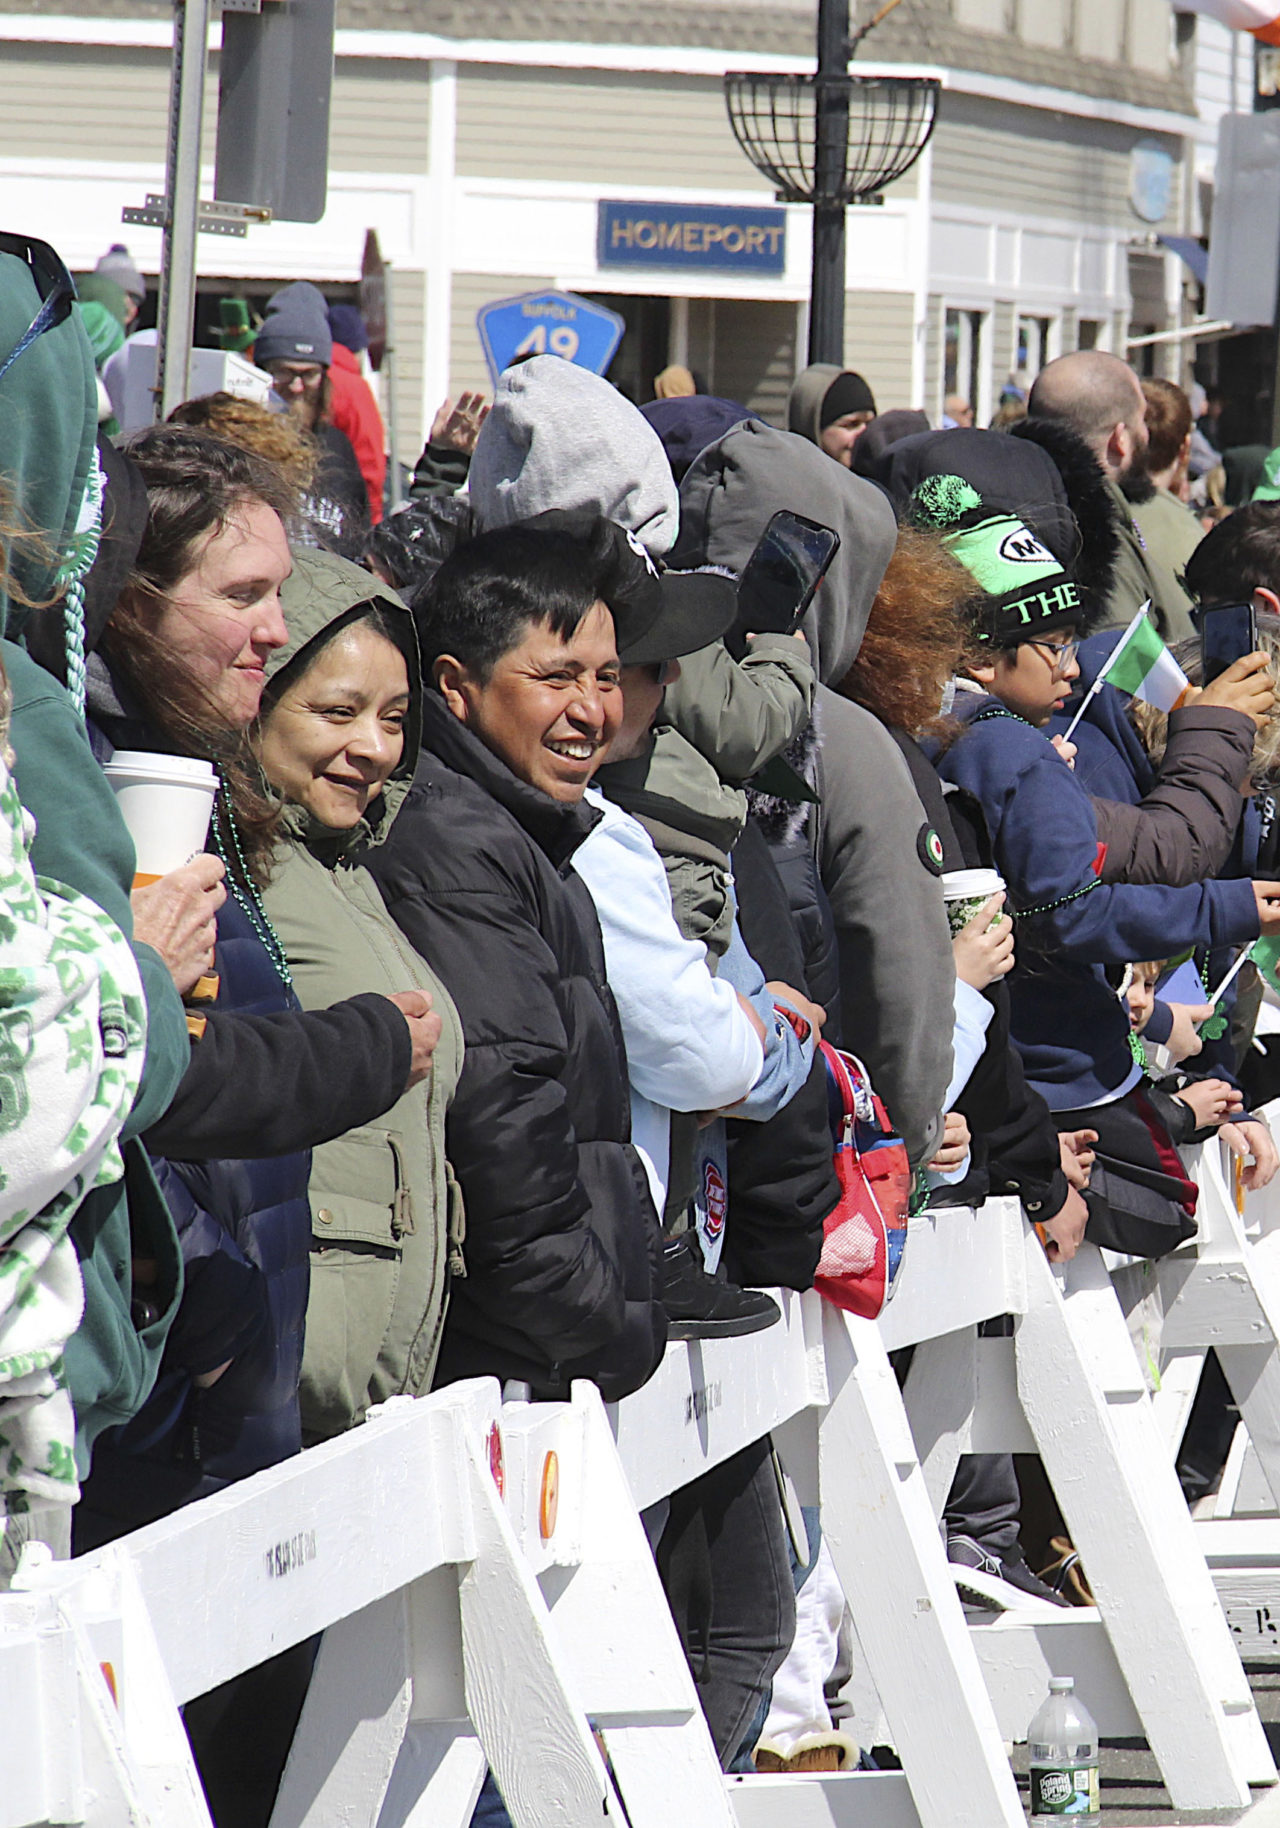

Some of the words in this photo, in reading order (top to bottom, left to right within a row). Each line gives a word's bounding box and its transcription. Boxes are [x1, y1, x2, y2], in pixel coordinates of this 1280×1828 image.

[612, 219, 784, 255] HOMEPORT
[514, 325, 580, 361] 49
[1002, 582, 1081, 624] THE
[1040, 1772, 1070, 1790] Poland
[1041, 1783, 1072, 1801] Spring
